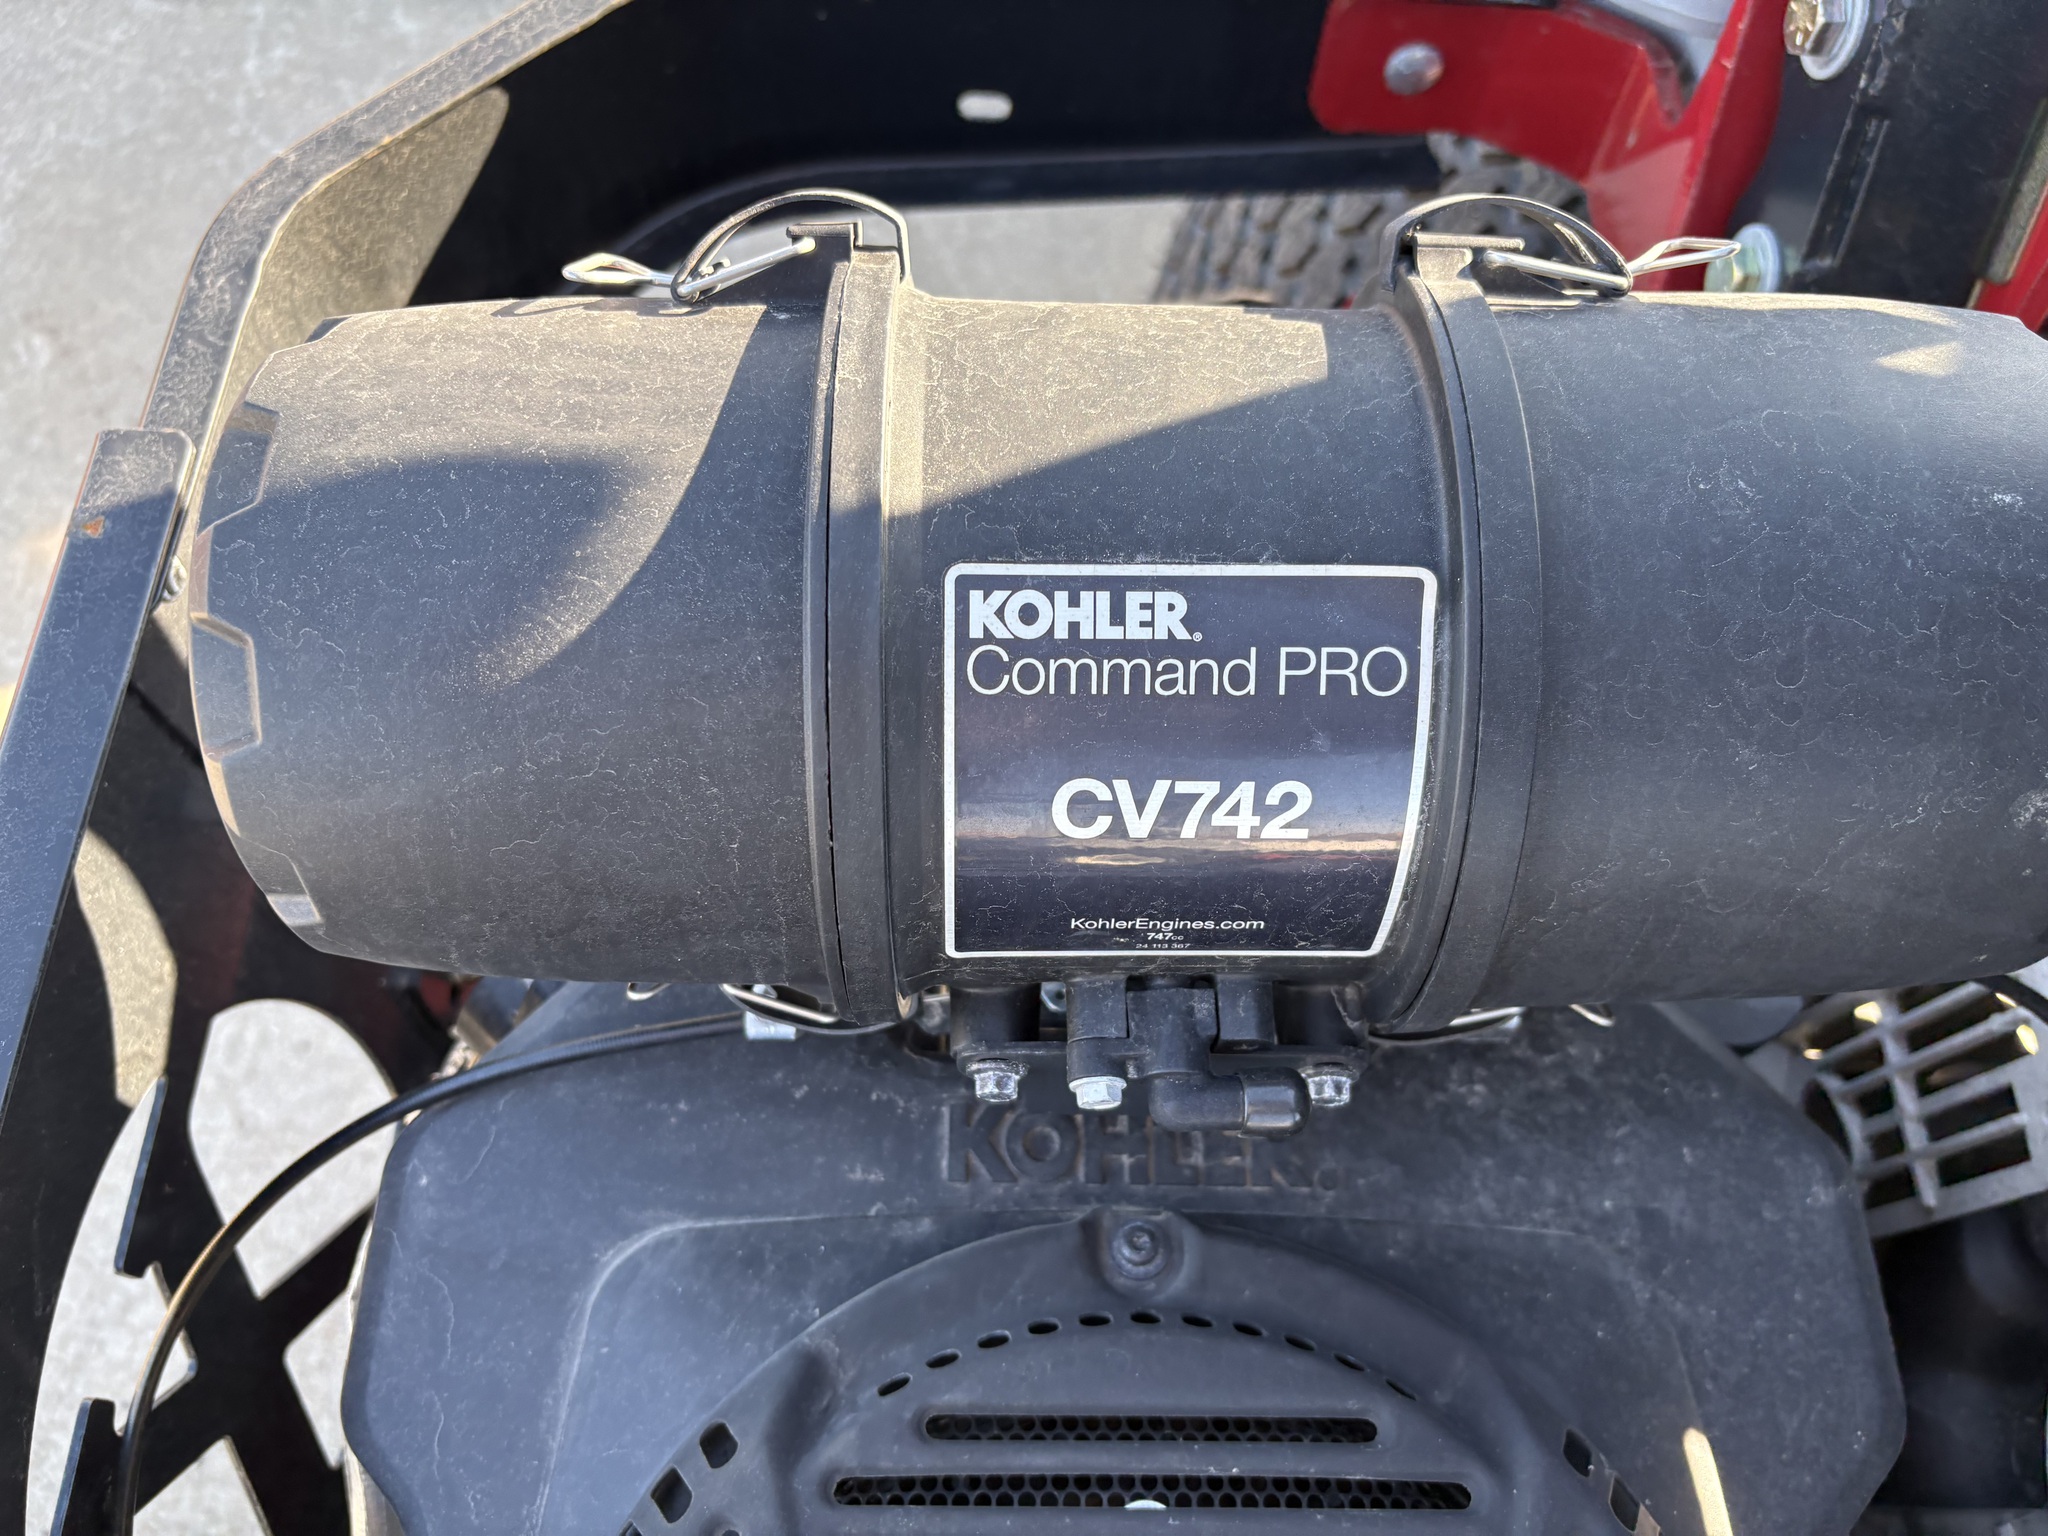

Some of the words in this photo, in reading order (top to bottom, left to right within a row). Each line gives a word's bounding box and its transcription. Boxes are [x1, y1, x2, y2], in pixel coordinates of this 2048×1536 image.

[966, 645, 1257, 696] Command
[1278, 645, 1408, 697] PRO
[1051, 778, 1314, 839] CV742
[1070, 917, 1265, 932] KohlerEngines.com
[1146, 932, 1184, 941] 747cc
